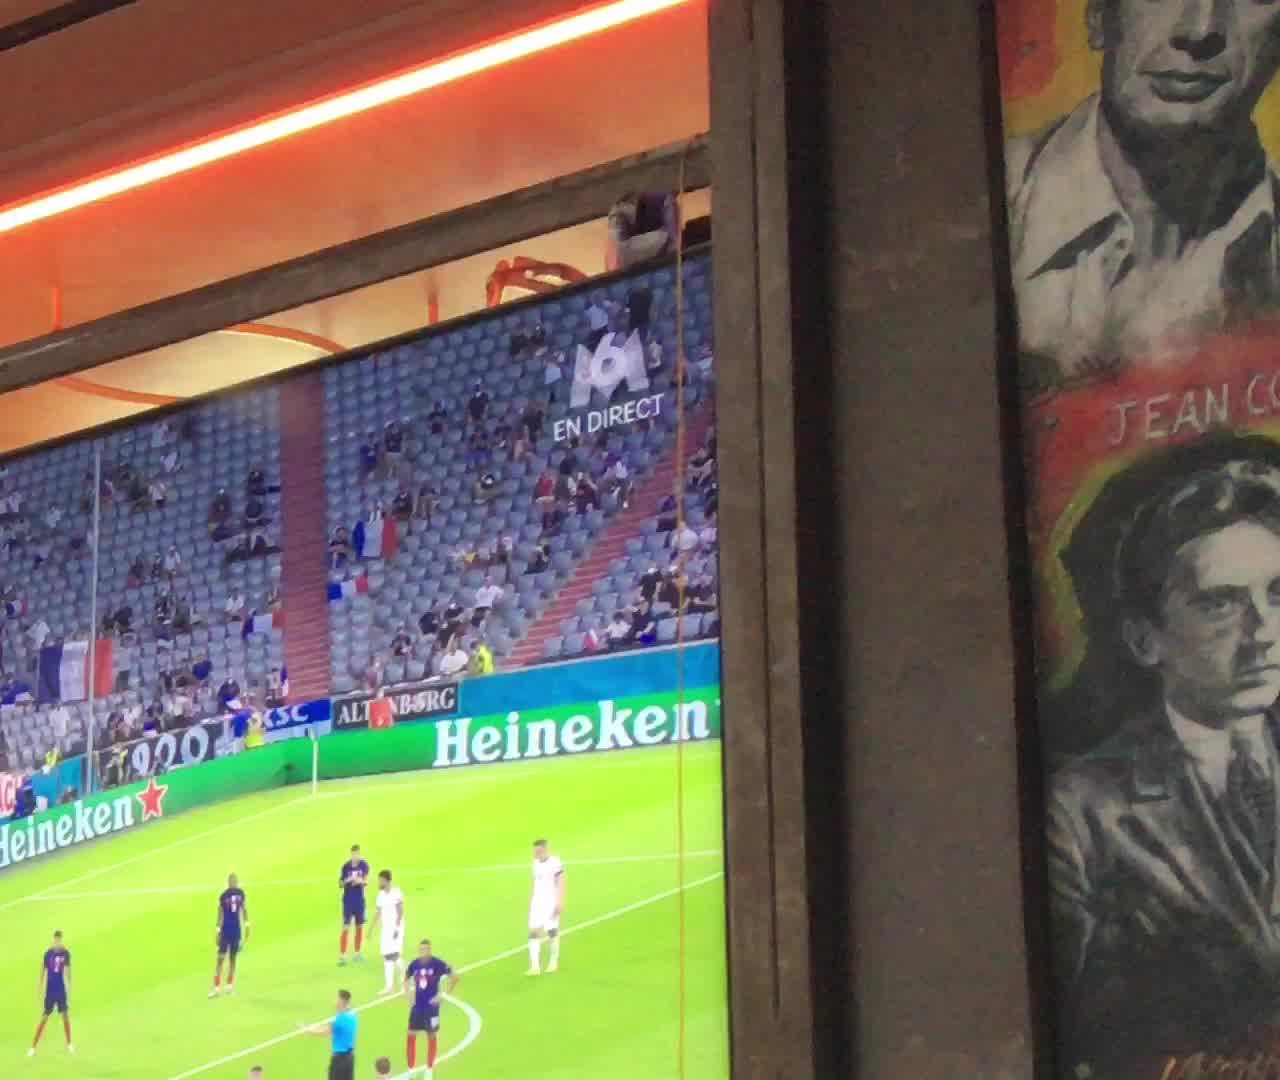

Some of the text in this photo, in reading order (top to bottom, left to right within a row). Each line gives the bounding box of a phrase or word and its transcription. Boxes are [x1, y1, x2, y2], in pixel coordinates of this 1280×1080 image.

[553, 393, 665, 441] EN DIRECT
[1110, 383, 1229, 446] JEAN
[433, 698, 708, 768] Heineken
